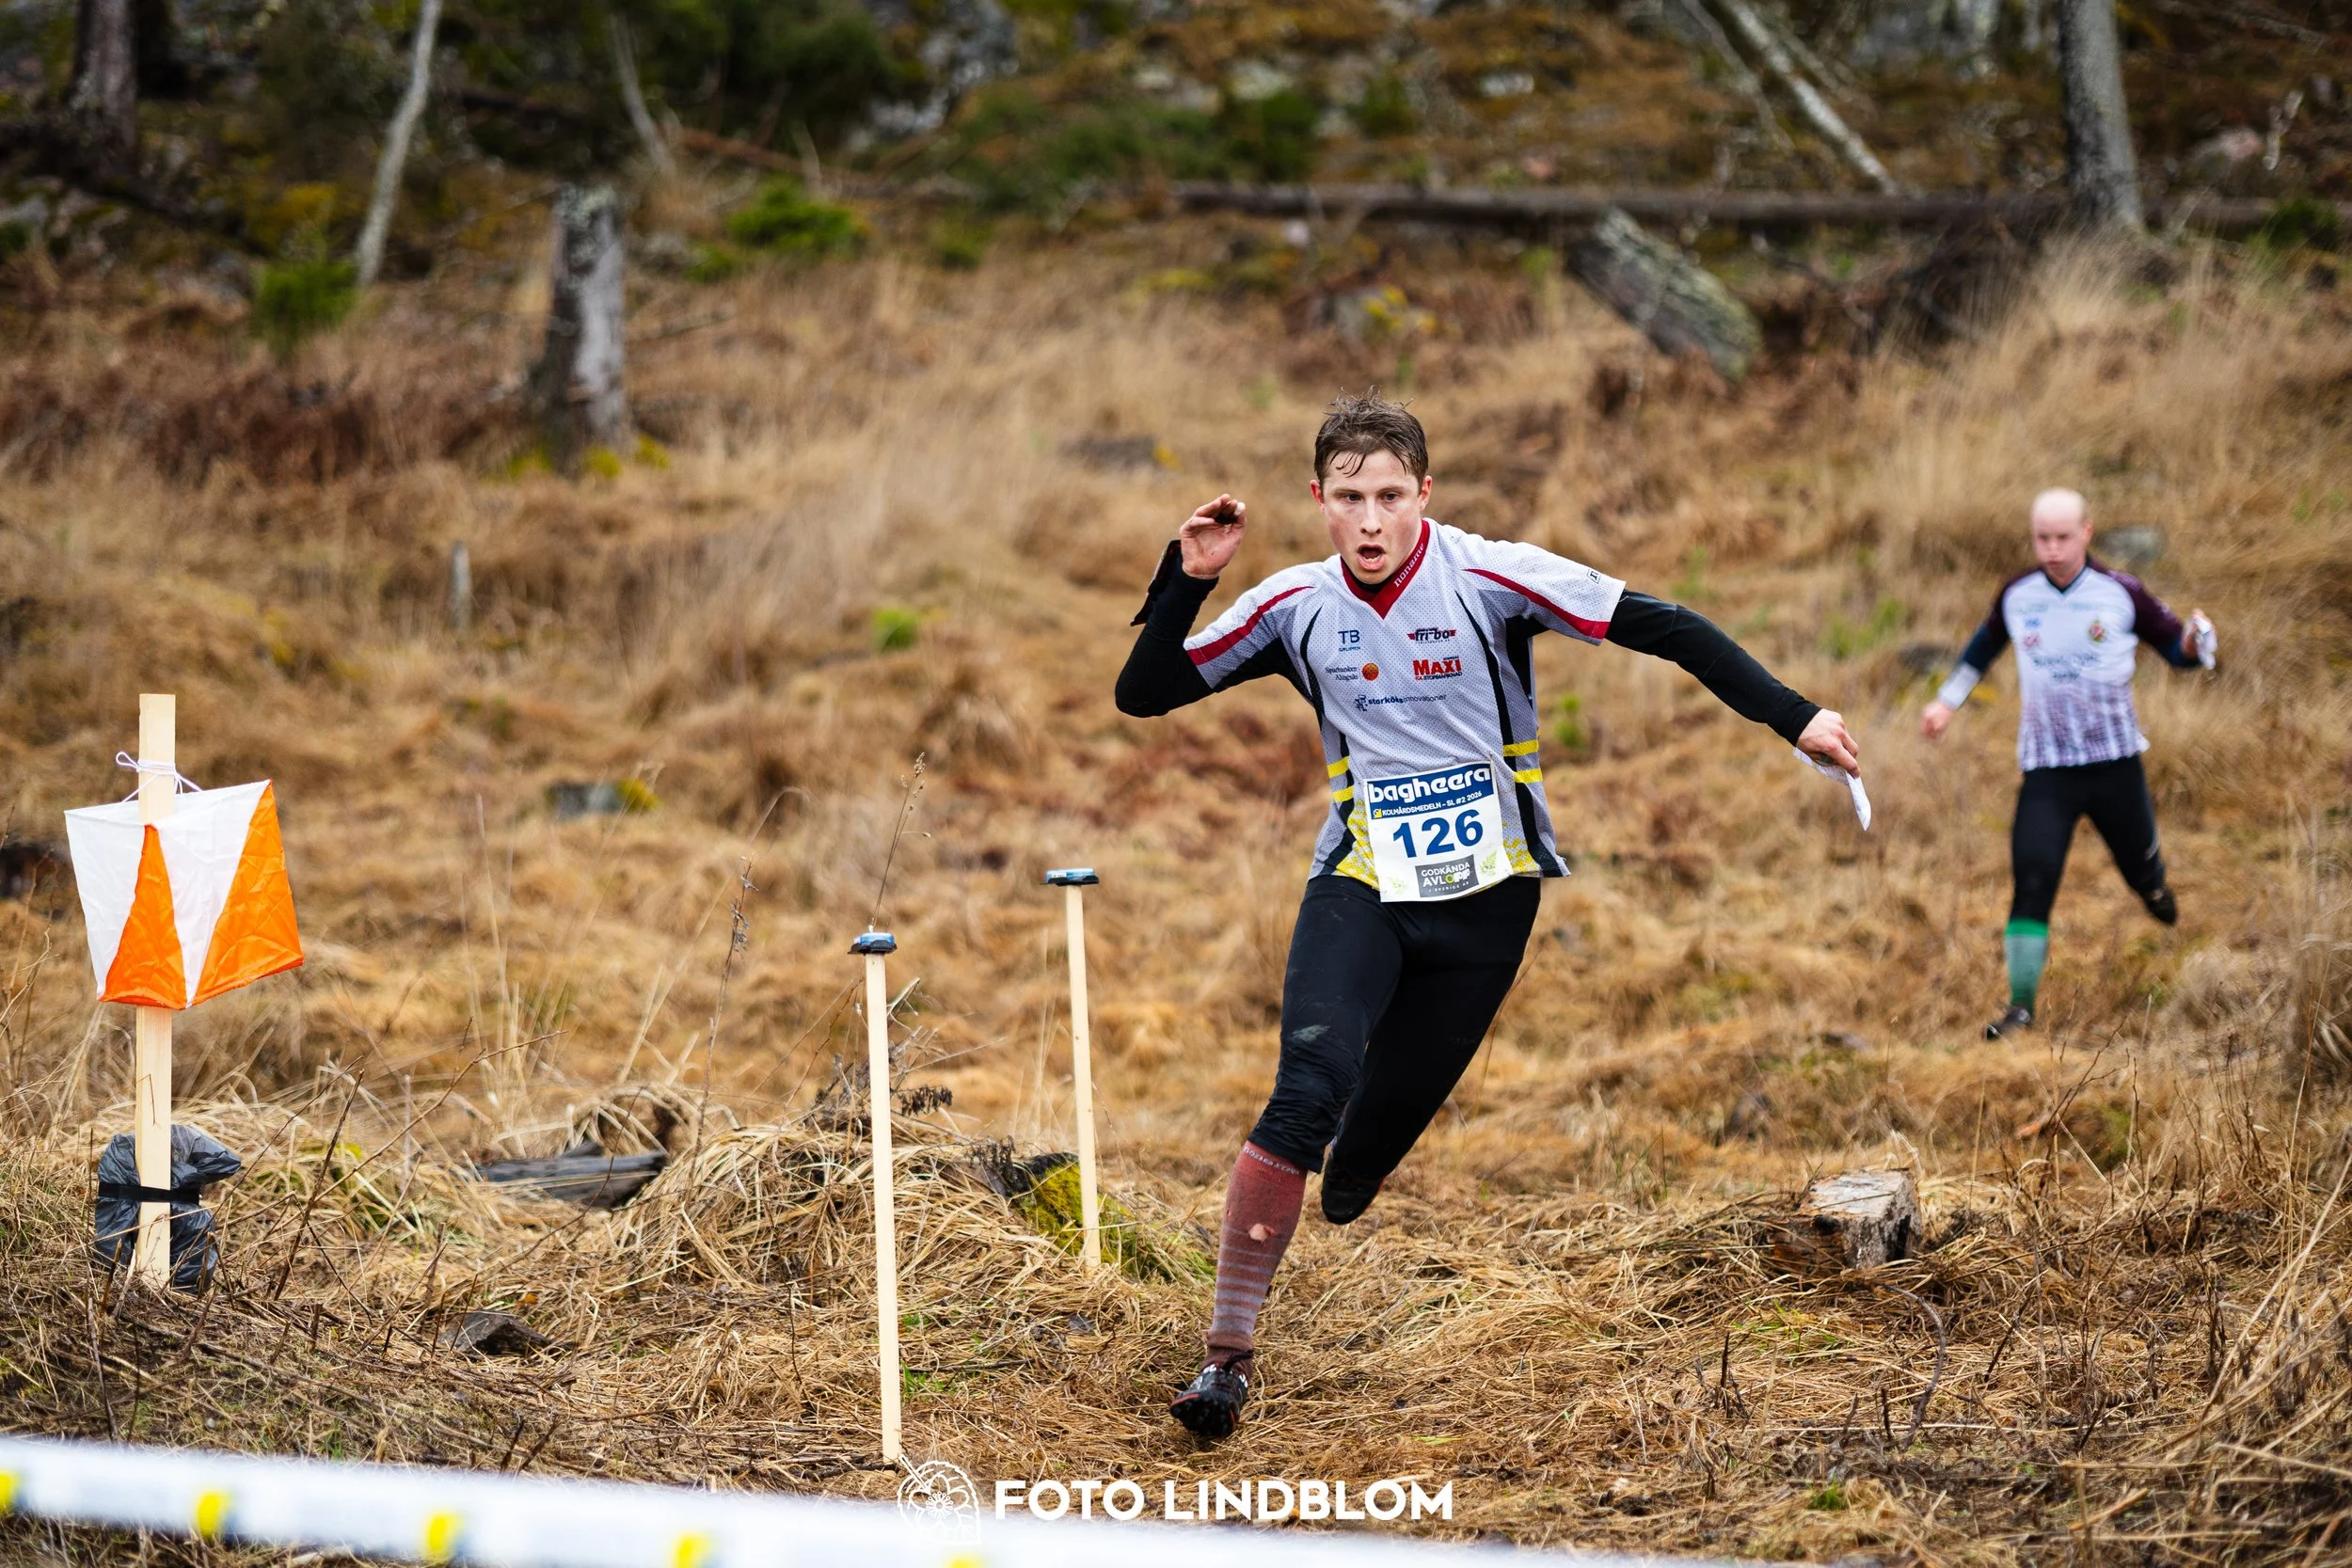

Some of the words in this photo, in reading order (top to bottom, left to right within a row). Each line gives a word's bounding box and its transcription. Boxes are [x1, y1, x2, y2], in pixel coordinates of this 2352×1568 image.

[1338, 629, 1359, 644] TB
[1369, 768, 1490, 803] bagheera
[1382, 801, 1442, 816] KOLMÅRDSMEDELN
[1467, 792, 1483, 801] 2026
[1392, 809, 1484, 859] 126
[1422, 862, 1470, 877] GODKÄNDA
